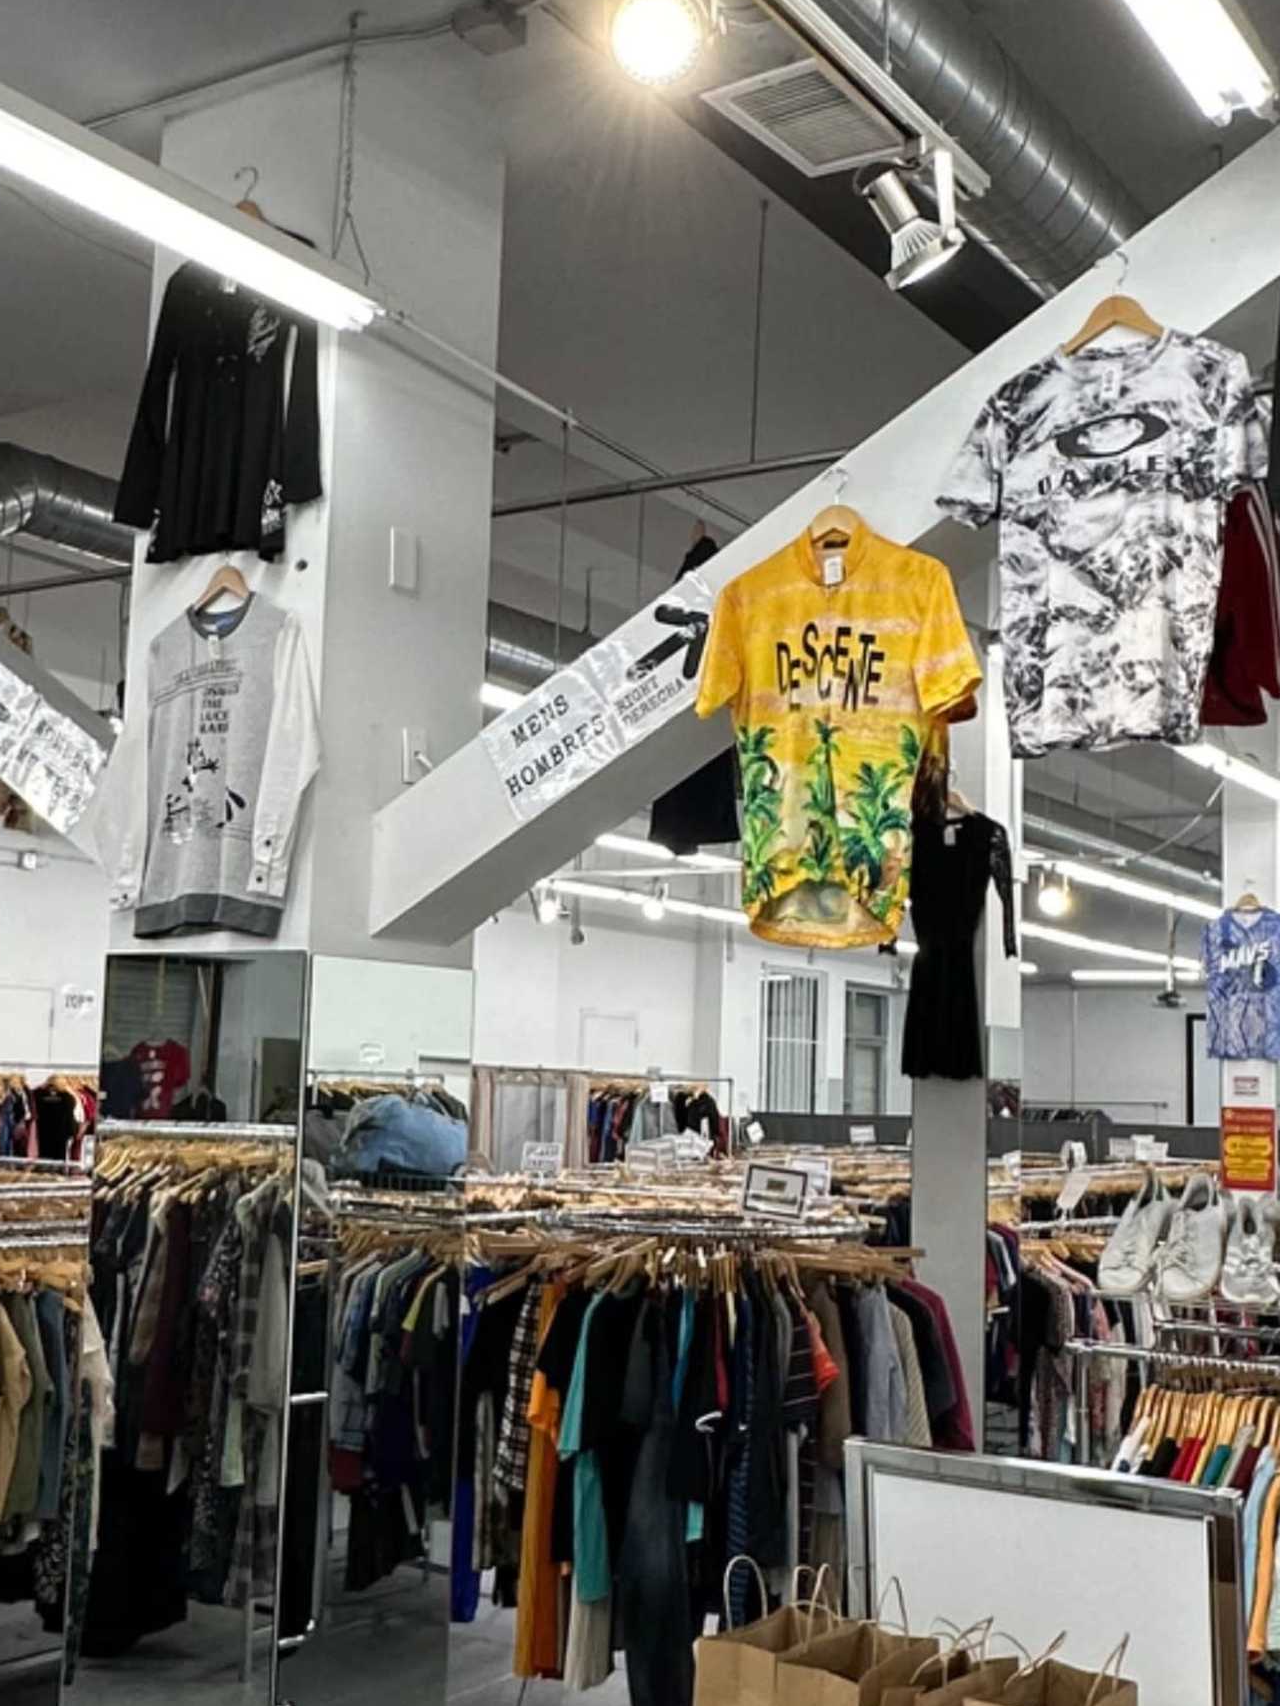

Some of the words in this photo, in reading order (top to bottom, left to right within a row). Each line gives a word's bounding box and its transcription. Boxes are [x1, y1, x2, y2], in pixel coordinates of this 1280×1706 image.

[776, 621, 884, 712] DESCENTE
[510, 694, 570, 749] MENS
[614, 675, 660, 715] RIGHT
[622, 677, 686, 727] DERECHA
[505, 713, 606, 797] HOMBRES
